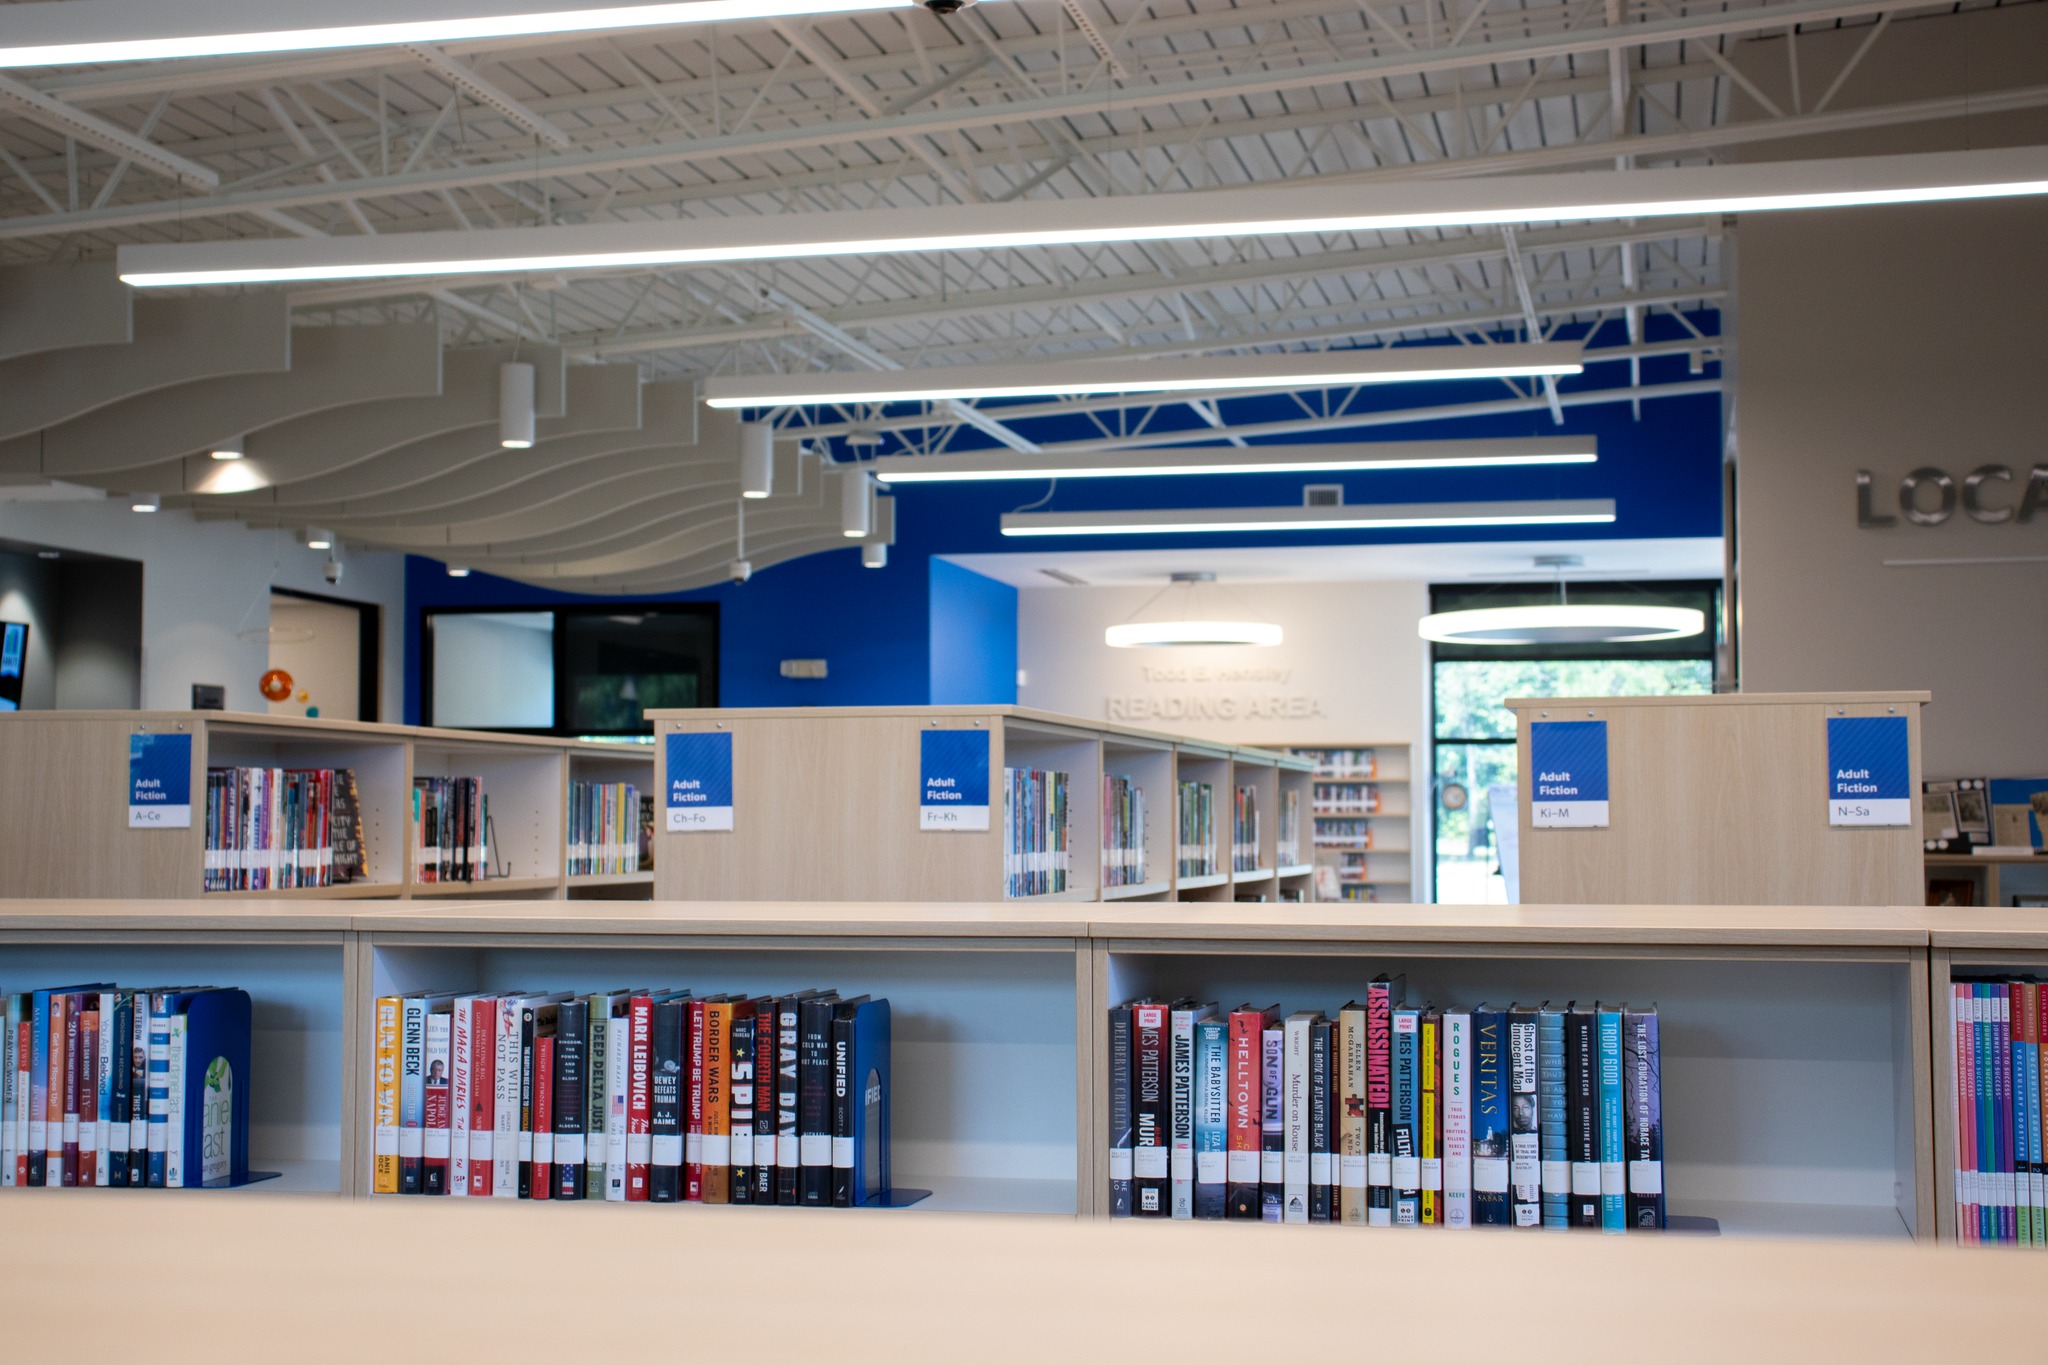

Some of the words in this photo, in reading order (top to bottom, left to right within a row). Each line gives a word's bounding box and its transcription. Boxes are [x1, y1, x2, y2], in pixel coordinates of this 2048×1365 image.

[1104, 697, 1238, 721] READING
[1244, 697, 1326, 720] AREA
[135, 779, 161, 788] Adult
[672, 779, 701, 789] Adult
[926, 778, 956, 787] Adult
[1539, 772, 1571, 782] Adult
[1837, 769, 1870, 779] Adult
[135, 791, 167, 800] Fiction
[672, 792, 707, 802] Fiction
[926, 790, 962, 800] Fiction
[1539, 785, 1578, 795] Fiction
[1837, 783, 1878, 793] Fiction
[135, 1001, 143, 1015] TIM
[458, 1008, 466, 1024] THE
[693, 1010, 703, 1029] LET
[68, 1021, 77, 1037] 20
[100, 1019, 109, 1038] You
[135, 1016, 143, 1041] TEBOW
[379, 1005, 396, 1048] RUN
[406, 1007, 421, 1044] GLENN
[474, 1012, 482, 1058] GOVERNMENT
[634, 1006, 648, 1042] MARK
[758, 1012, 772, 1034] THE
[1637, 1024, 1646, 1038] THE
[6, 1029, 14, 1066] PRAYING
[52, 1032, 60, 1047] Get
[456, 1026, 468, 1063] MAGA
[497, 1034, 507, 1063] NOT
[508, 1031, 519, 1063] THIS
[594, 1025, 605, 1057] DEEP
[692, 1030, 702, 1066] TRUMP
[708, 1010, 720, 1063] BORDER
[780, 1012, 797, 1079] GRAY
[1314, 1037, 1324, 1051] THE
[1367, 986, 1390, 1108] ASSASSINATED!
[1512, 1024, 1524, 1068] Innocent
[1524, 1024, 1535, 1053] Ghost
[1602, 1023, 1617, 1055] TROOP
[51, 1048, 60, 1065] Your
[405, 1047, 420, 1076] BECK
[757, 1037, 771, 1084] FOURTH
[1114, 1022, 1126, 1083] DELIBERATE
[1175, 1034, 1190, 1074] JAMES
[1210, 1045, 1221, 1062] THE
[1265, 1040, 1278, 1067] SON
[1524, 1056, 1534, 1065] of
[1637, 1041, 1647, 1059] LOST
[1995, 1056, 2000, 1065] TO
[2004, 1056, 2009, 1065] TO
[99, 1056, 109, 1095] Beloved
[379, 1055, 395, 1084] TO
[692, 1068, 702, 1081] BE
[836, 1041, 846, 1097] UNIFIED
[1142, 1049, 1159, 1102] PATTERSON
[1269, 1070, 1278, 1080] OF
[1314, 1053, 1324, 1074] BOOK
[1480, 1023, 1498, 1115] VERITAS
[1524, 1067, 1534, 1084] the
[1582, 1070, 1588, 1078] AN
[1602, 1058, 1618, 1085] 6000
[5, 1069, 13, 1103] WOMEN
[50, 1067, 59, 1090] Hopes
[456, 1067, 468, 1109] DIARIES
[496, 1068, 506, 1100] PASS
[507, 1069, 518, 1103] WILL
[593, 1061, 604, 1100] DELTA
[633, 1045, 648, 1110] LEIBOVICH
[654, 1076, 676, 1084] DEWEY
[654, 1086, 676, 1094] DEFEATS
[708, 1067, 719, 1103] WARS
[1238, 1037, 1249, 1129] HELLTOWN
[1291, 1073, 1302, 1108] Murder
[1314, 1075, 1324, 1083] OF
[1399, 1057, 1412, 1121] PATTERSON
[1512, 1071, 1523, 1091] Man
[1638, 1062, 1648, 1101] EDUCATION
[50, 1093, 58, 1107] Up!
[82, 1088, 91, 1107] FLY
[133, 1094, 141, 1112] THIS
[438, 1095, 447, 1118] JUDGE
[538, 1081, 546, 1118] DEMOCRACY
[691, 1083, 701, 1119] TRUMP
[757, 1086, 771, 1112] MAN
[1175, 1076, 1190, 1139] PATTERSON
[1210, 1066, 1221, 1123] BABYSITTER
[1265, 1086, 1279, 1120] GUN
[1314, 1085, 1324, 1121] ATLANTIS
[133, 1113, 141, 1121] IS
[779, 1092, 796, 1137] DAY
[1114, 1087, 1127, 1131] CRUELTY
[1291, 1109, 1299, 1122] on
[1639, 1105, 1649, 1114] OF
[1211, 1131, 1221, 1147] LIZA
[1291, 1124, 1301, 1151] Rouse
[1313, 1123, 1324, 1147] BLACK
[1639, 1117, 1649, 1146] HORACE
[2032, 1114, 2040, 1160] BOOSTERS
[760, 1173, 769, 1192] BAER
[1477, 1194, 1504, 1202] SABAR
